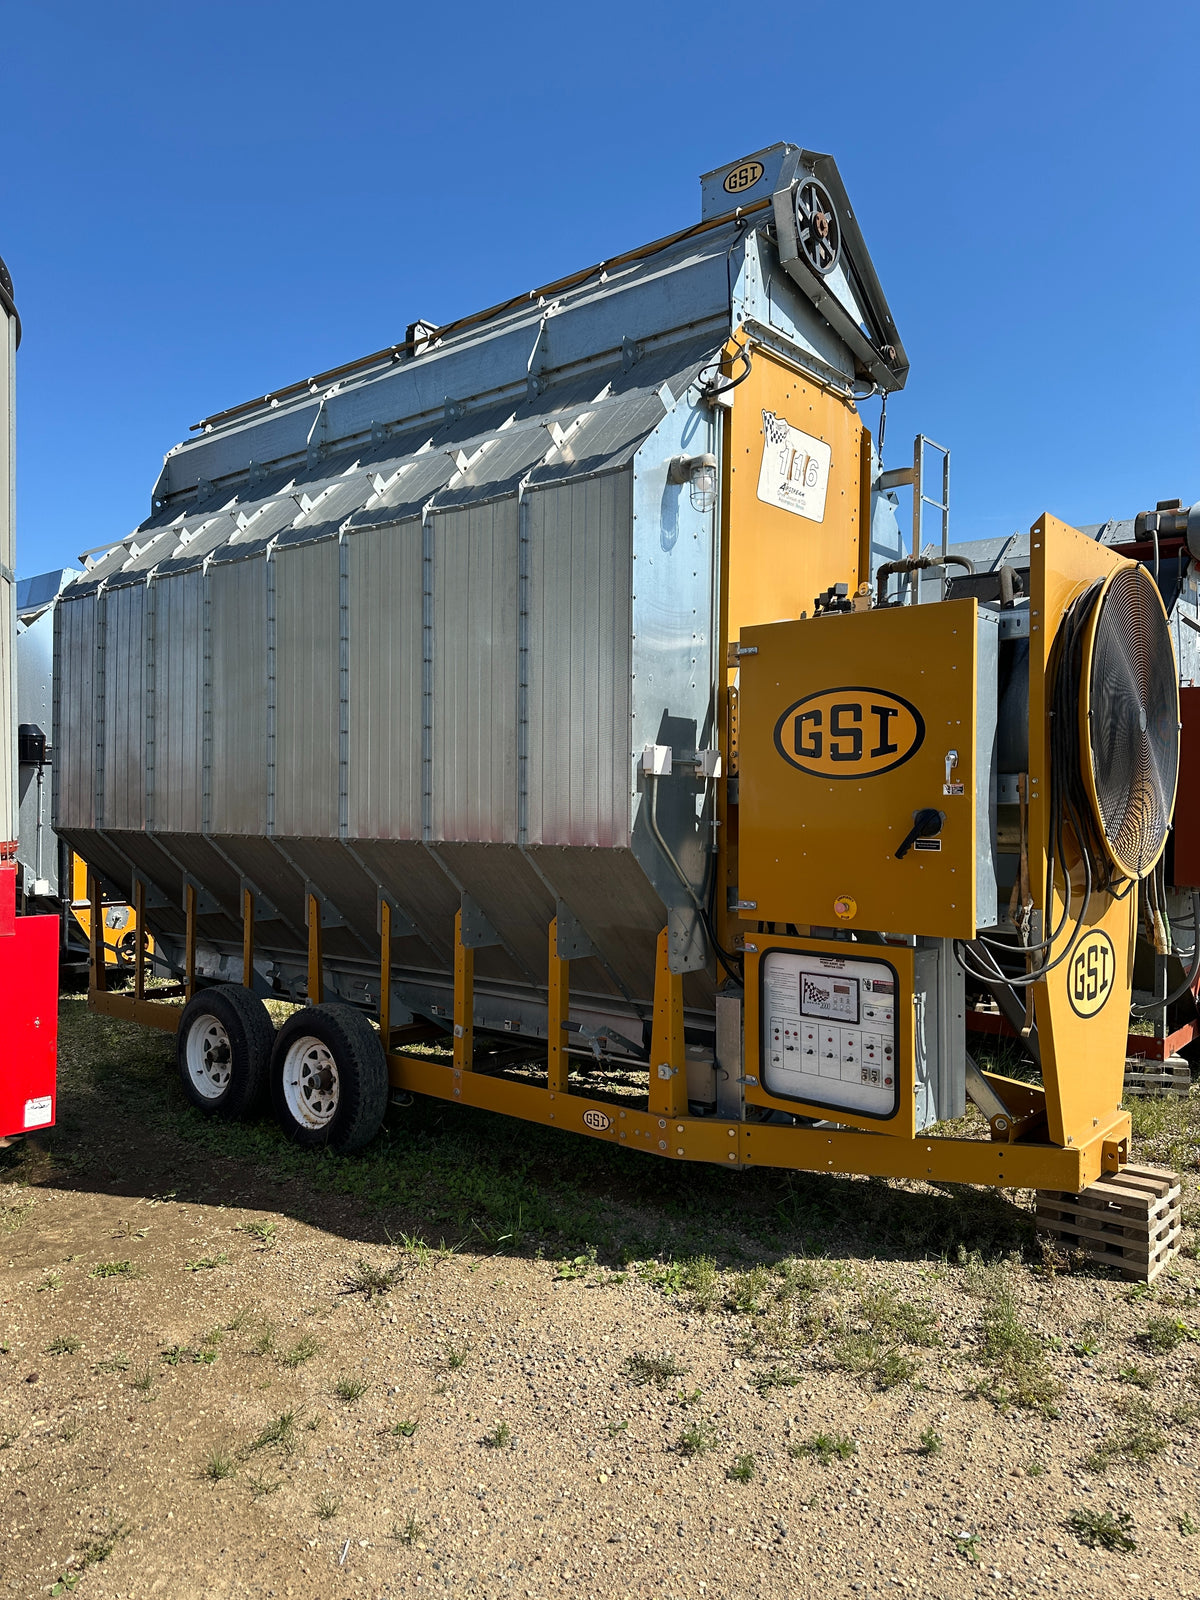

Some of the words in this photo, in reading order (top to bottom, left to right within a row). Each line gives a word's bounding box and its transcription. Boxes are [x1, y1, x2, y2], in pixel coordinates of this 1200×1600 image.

[728, 165, 758, 190] GSI
[779, 447, 819, 487] 116
[794, 703, 899, 762] GSI
[1074, 944, 1109, 1001] GSI
[586, 1113, 606, 1128] GSI
